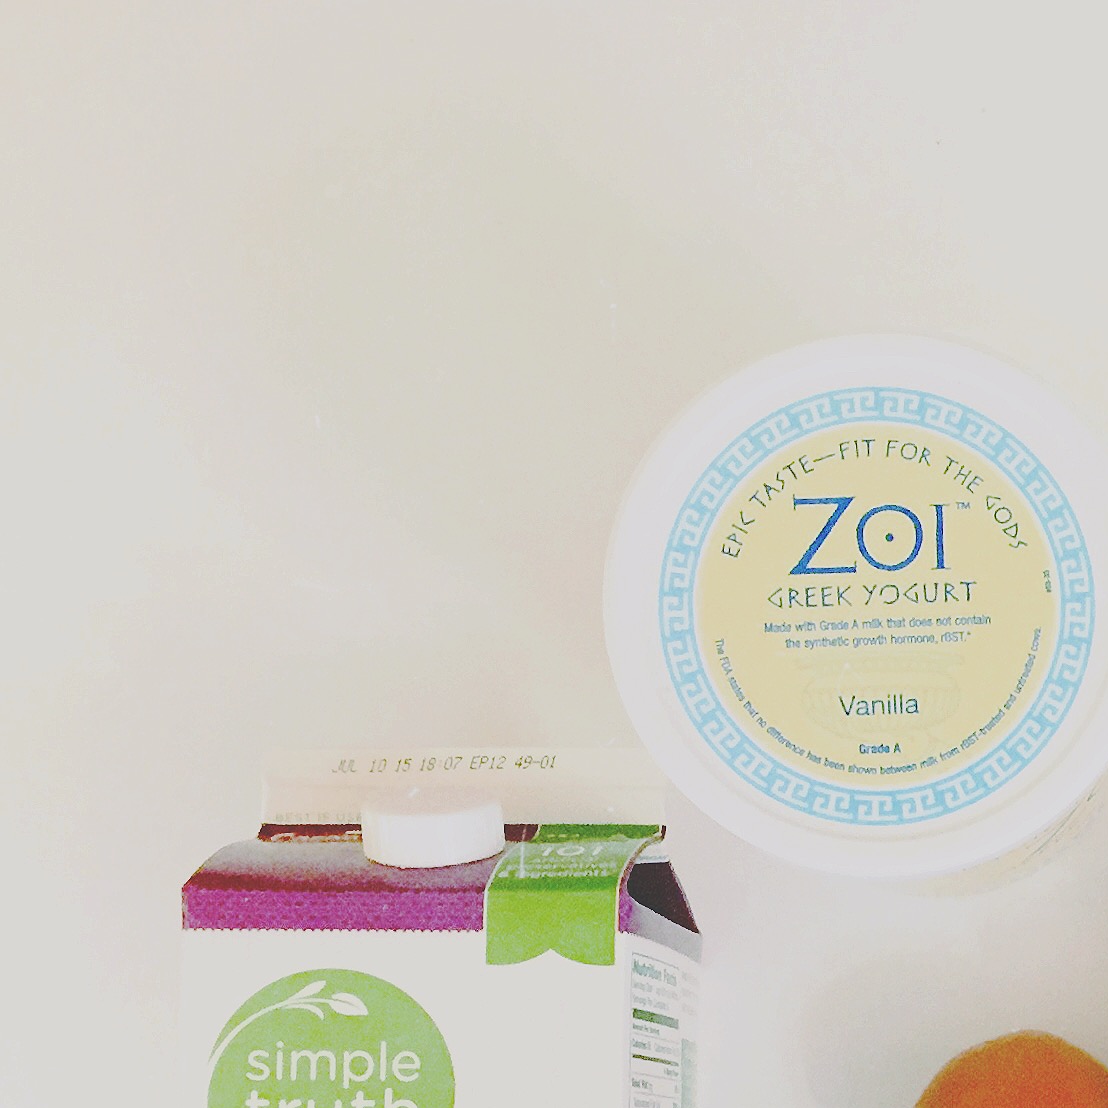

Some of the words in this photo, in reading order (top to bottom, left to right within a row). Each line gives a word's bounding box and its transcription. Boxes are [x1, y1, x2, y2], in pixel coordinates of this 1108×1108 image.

[721, 511, 756, 558] EPIC
[886, 439, 931, 467] FOR
[943, 455, 984, 494] THE
[985, 494, 1028, 549] GODS
[788, 493, 952, 576] ZOI
[767, 585, 853, 609] GREEK
[862, 581, 977, 606] YOGURT
[764, 621, 792, 633] Made
[795, 620, 816, 632] with
[819, 619, 849, 631] Grade
[851, 618, 859, 629] A
[862, 618, 883, 629] milk
[886, 617, 906, 628] that
[908, 616, 934, 628] does
[936, 616, 952, 627] not
[954, 614, 992, 626] contain
[785, 637, 801, 649] the
[804, 635, 850, 650] synthetic
[852, 633, 887, 649] growth
[890, 633, 939, 646] hormone,
[714, 638, 725, 656] The
[720, 656, 733, 676] FDA
[743, 700, 758, 719] that
[756, 716, 768, 729] no
[766, 726, 807, 757] difference
[806, 750, 822, 765] has
[823, 757, 846, 771] been
[847, 764, 878, 775] shown
[879, 762, 918, 775] between
[919, 755, 939, 769] milk
[939, 746, 961, 762] from
[1003, 693, 1017, 711] and
[838, 693, 919, 717] Vanilla
[858, 742, 890, 755] Grade
[893, 742, 902, 754] A
[368, 757, 388, 773] 10
[394, 757, 412, 773] 15
[469, 754, 507, 771] EP12
[513, 754, 558, 770] 49-01
[245, 1040, 422, 1089] simple
